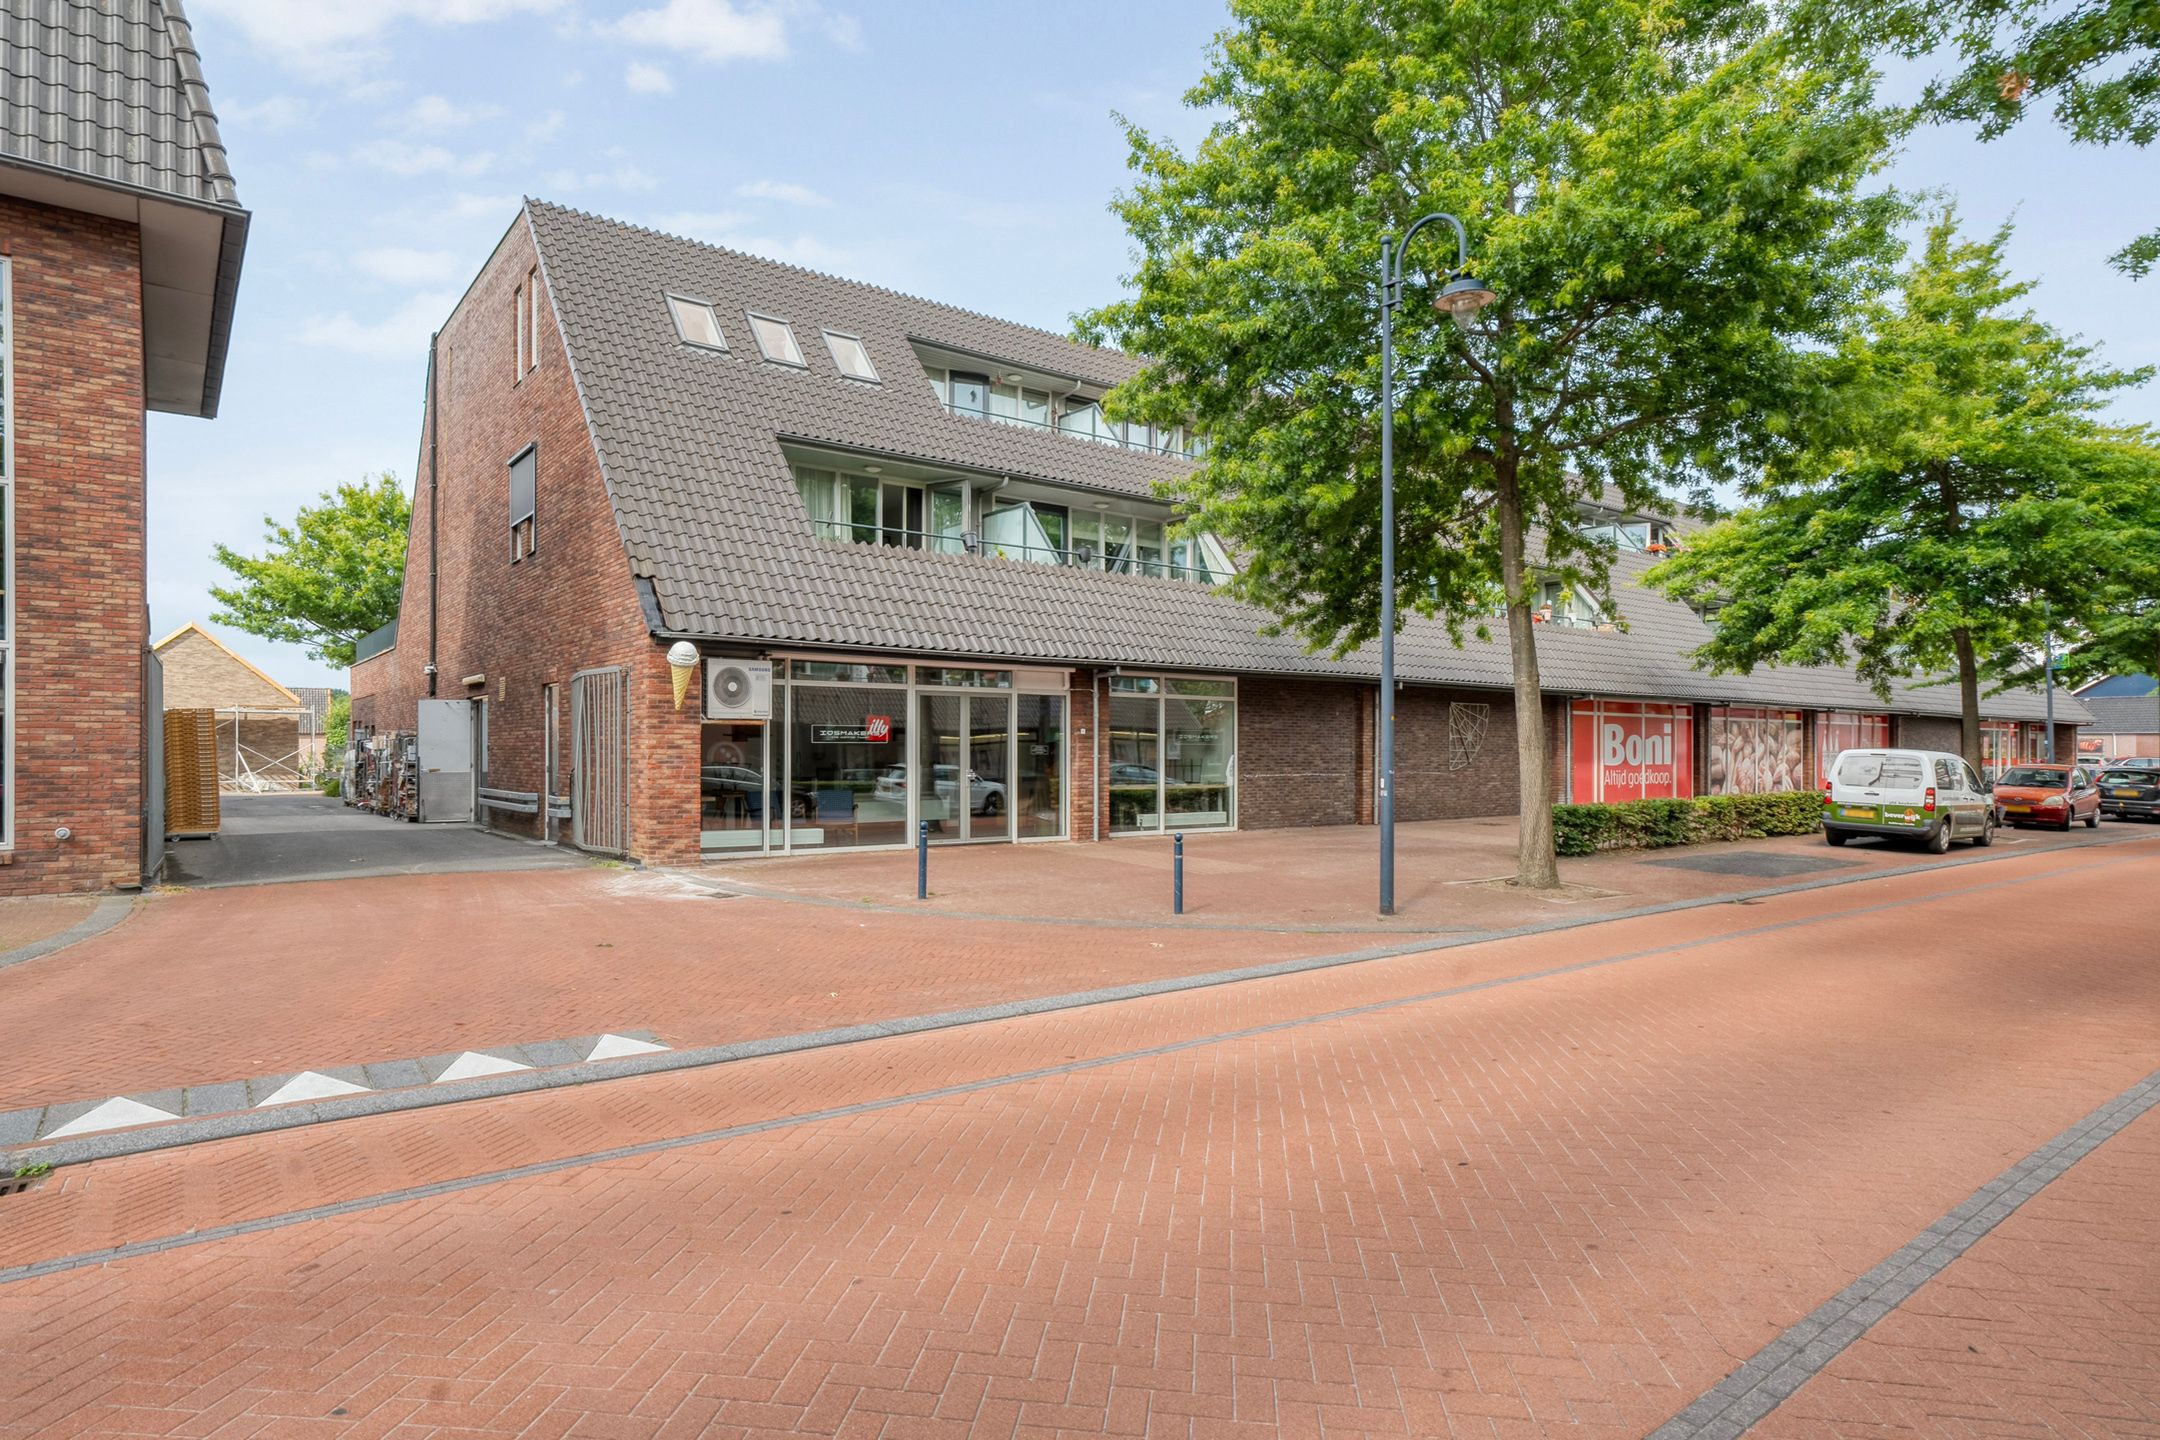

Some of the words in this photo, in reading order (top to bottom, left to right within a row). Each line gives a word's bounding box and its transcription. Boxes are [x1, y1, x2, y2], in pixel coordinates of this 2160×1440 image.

[869, 718, 889, 738] illy
[1604, 722, 1672, 767] Boni
[1604, 769, 1627, 789] Altijd
[1627, 769, 1672, 788] goedkoop.
